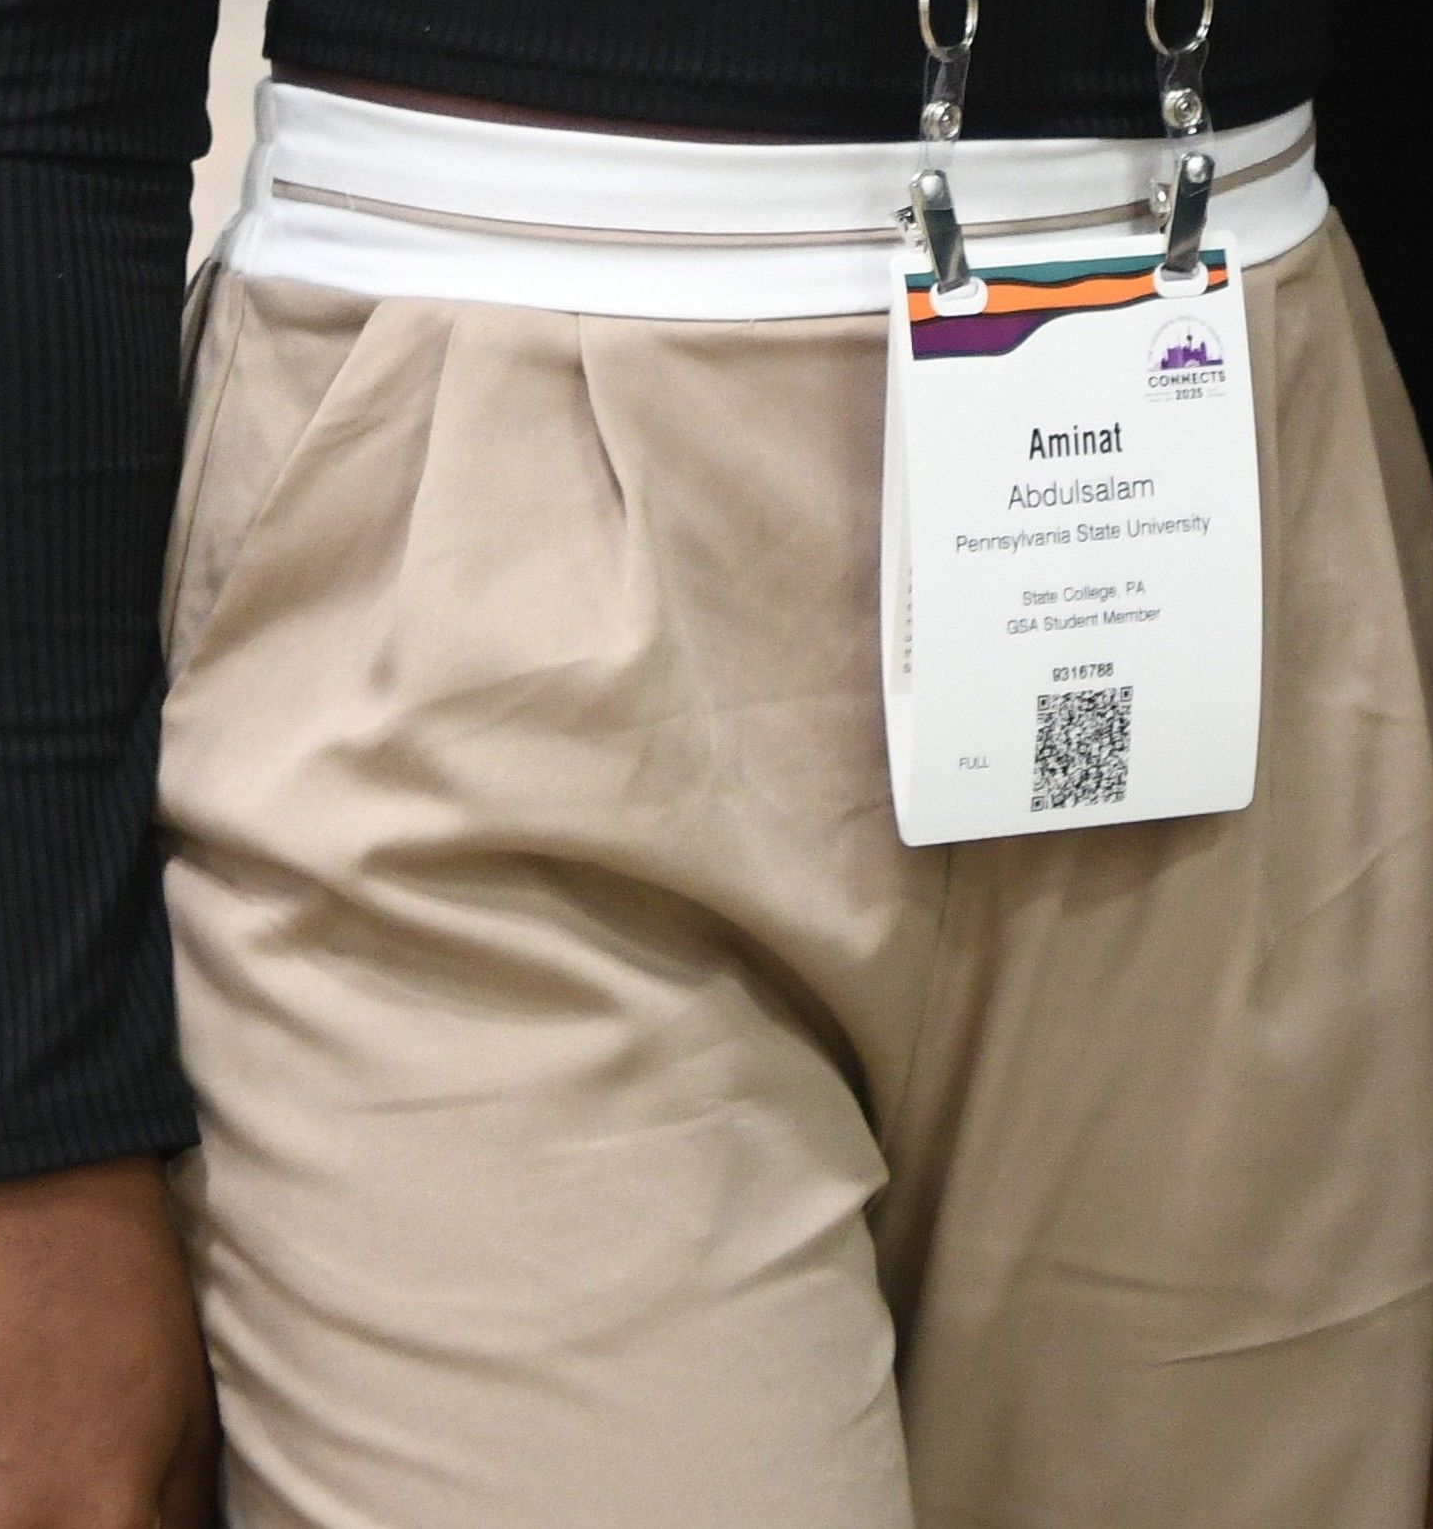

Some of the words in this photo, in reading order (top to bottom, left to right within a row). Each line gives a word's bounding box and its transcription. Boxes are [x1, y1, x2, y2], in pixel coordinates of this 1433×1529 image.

[1147, 370, 1227, 388] CONNECTS
[1175, 388, 1204, 401] 2025
[1029, 422, 1123, 460] Aminat
[1008, 476, 1155, 510] Abdulsalam
[955, 527, 1071, 554] Pennsylvania
[1077, 520, 1121, 543] State
[1127, 513, 1211, 539] University
[1022, 590, 1058, 606] State
[1063, 583, 1120, 604] College,
[1125, 580, 1146, 594] PA
[1006, 618, 1039, 635] GSA
[1043, 614, 1099, 632] Student
[1103, 607, 1161, 626] Member
[958, 756, 991, 770] FULL
